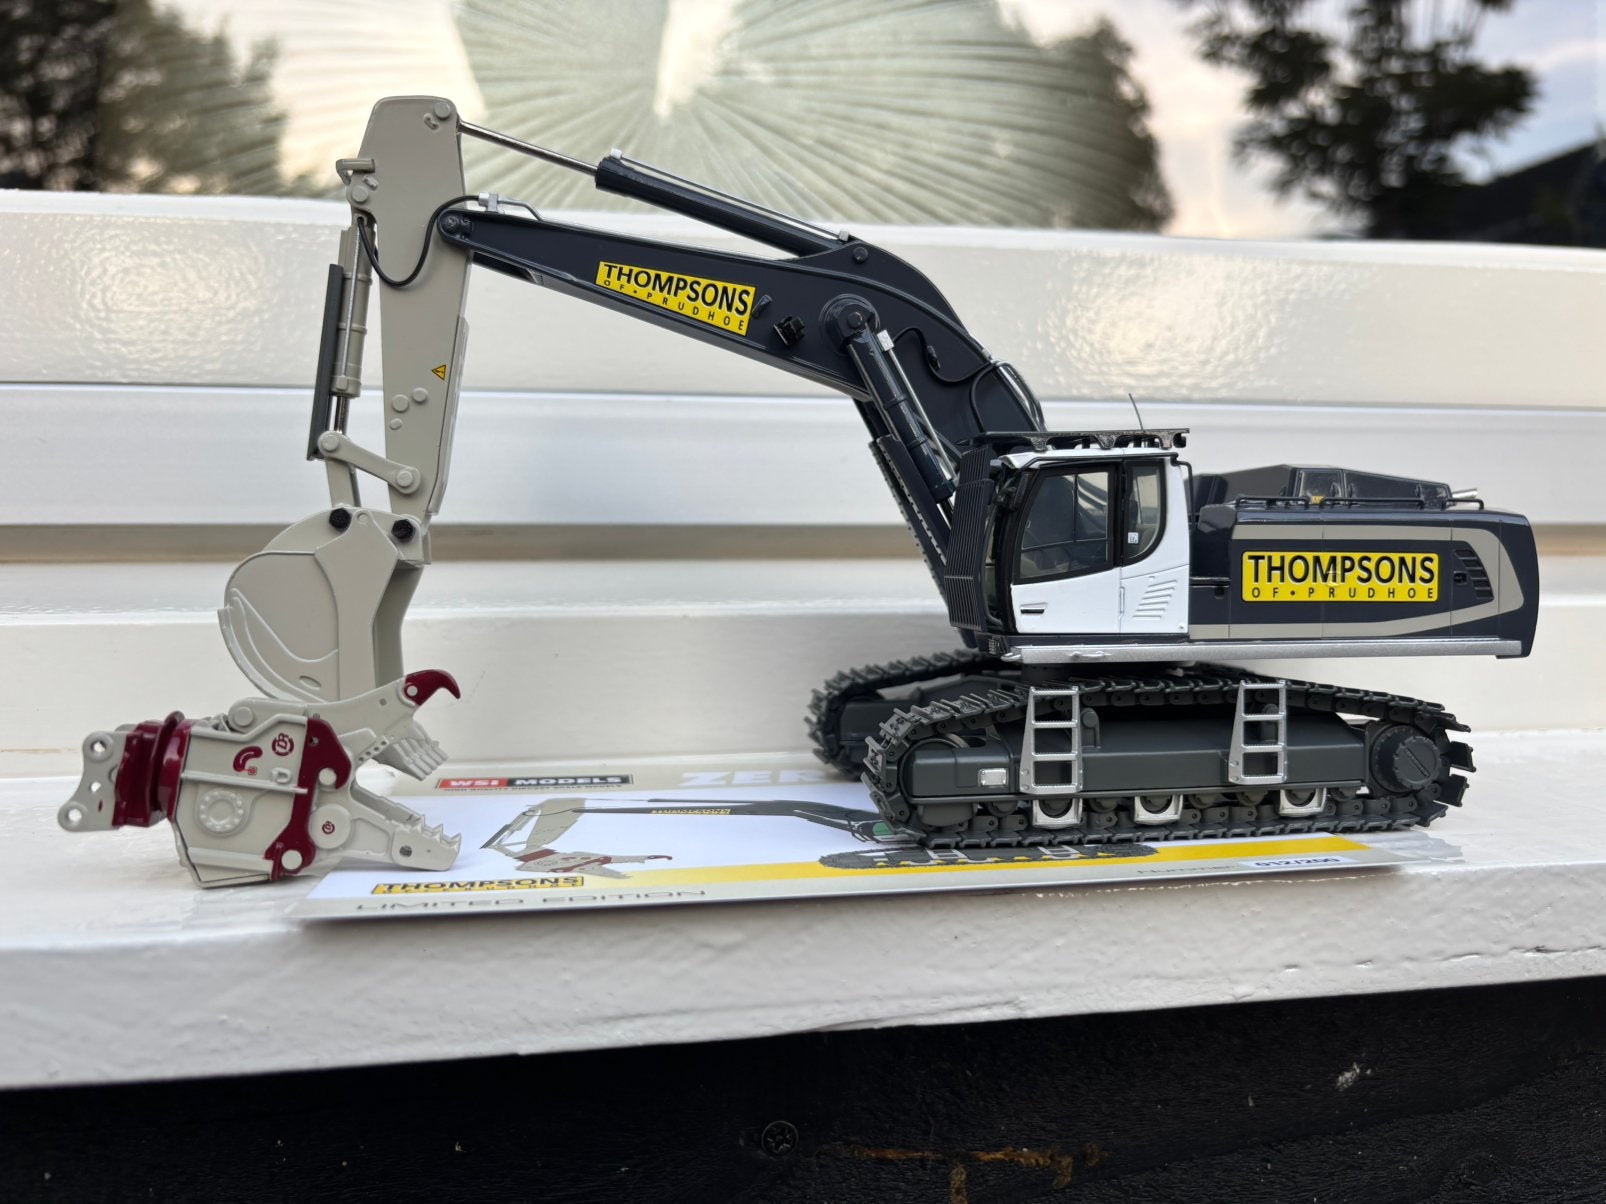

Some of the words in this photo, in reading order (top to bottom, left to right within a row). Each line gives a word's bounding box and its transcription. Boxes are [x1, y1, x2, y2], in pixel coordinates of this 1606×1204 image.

[604, 264, 750, 316] THOMPSONS
[1248, 555, 1434, 584] THOMPSONS
[449, 779, 499, 787] WSI
[514, 776, 622, 786] MODELS
[383, 876, 580, 890] THOMPSONS
[356, 898, 523, 910] LIMITED
[543, 890, 706, 902] EDITION
